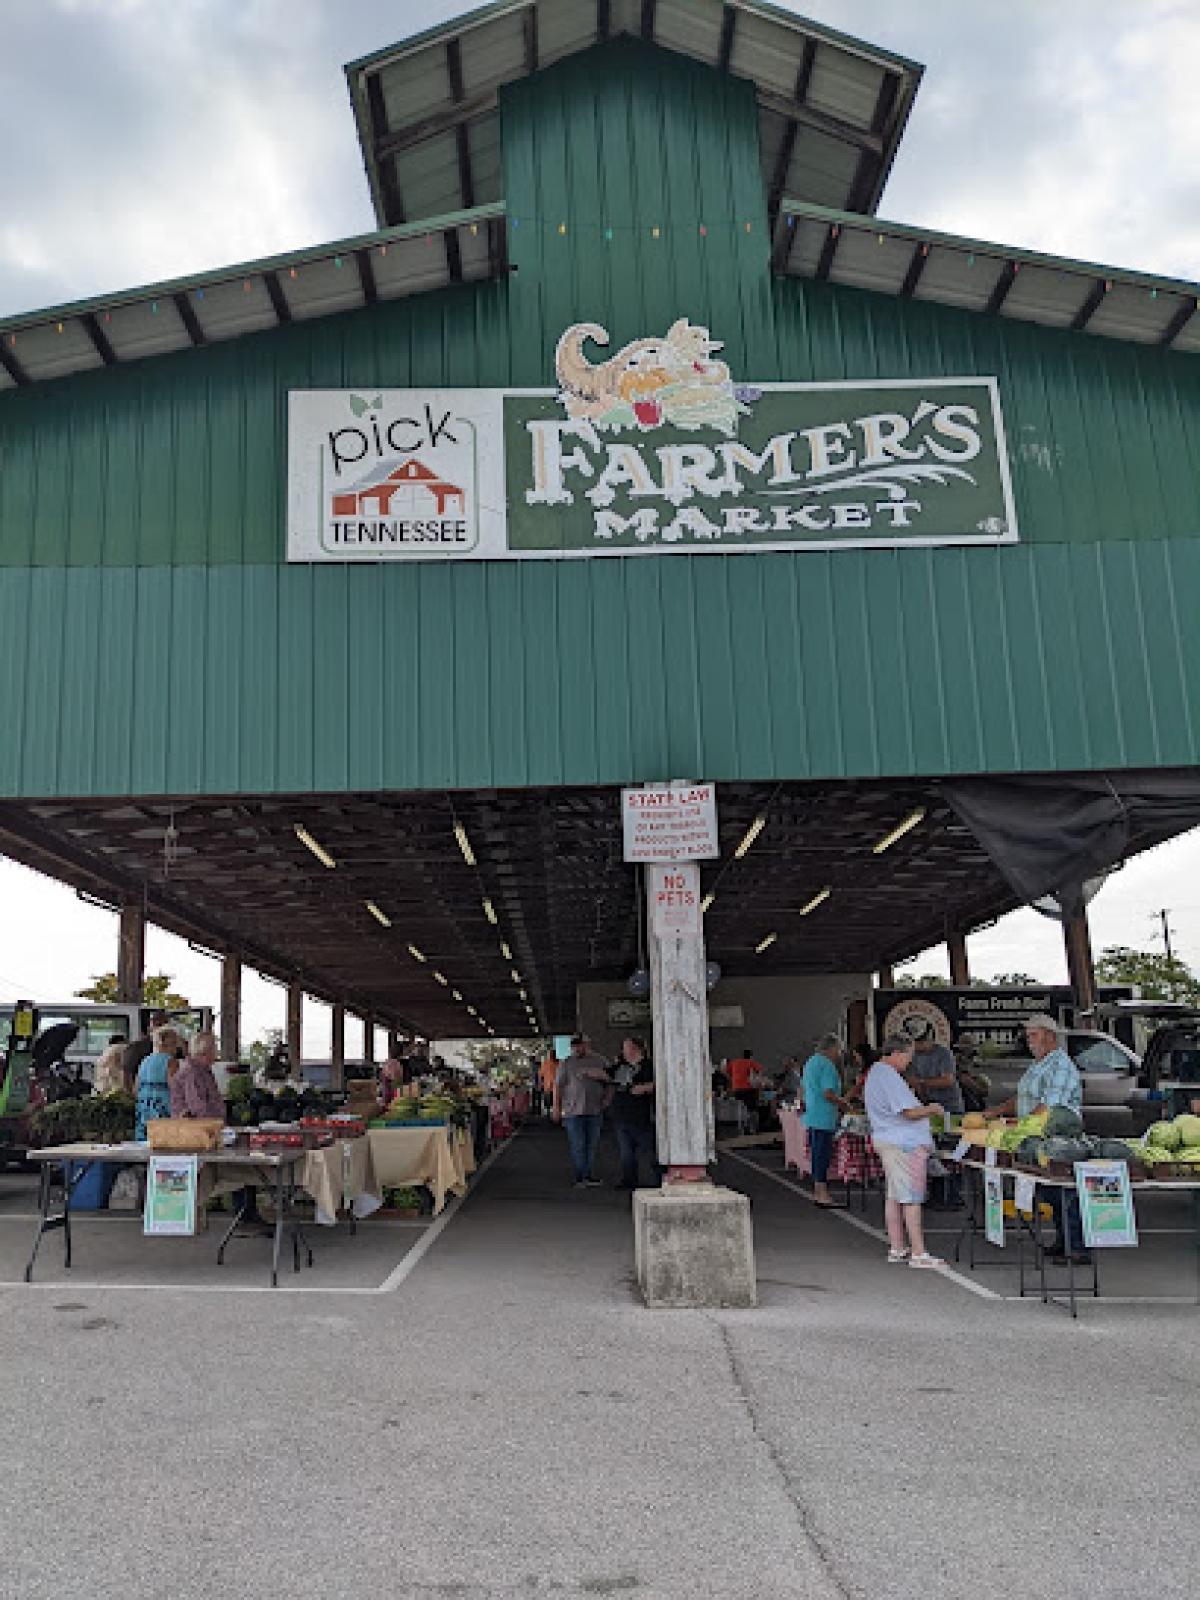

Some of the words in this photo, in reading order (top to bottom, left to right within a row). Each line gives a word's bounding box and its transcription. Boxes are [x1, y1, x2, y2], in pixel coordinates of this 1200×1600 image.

[328, 403, 459, 477] pick
[525, 399, 982, 506] FARMER'S
[329, 520, 468, 542] TENNESSEE
[593, 502, 922, 541] MARKET
[629, 791, 675, 807] STATE
[679, 787, 710, 804] LAW
[664, 875, 686, 889] NO
[656, 890, 695, 907] PETS
